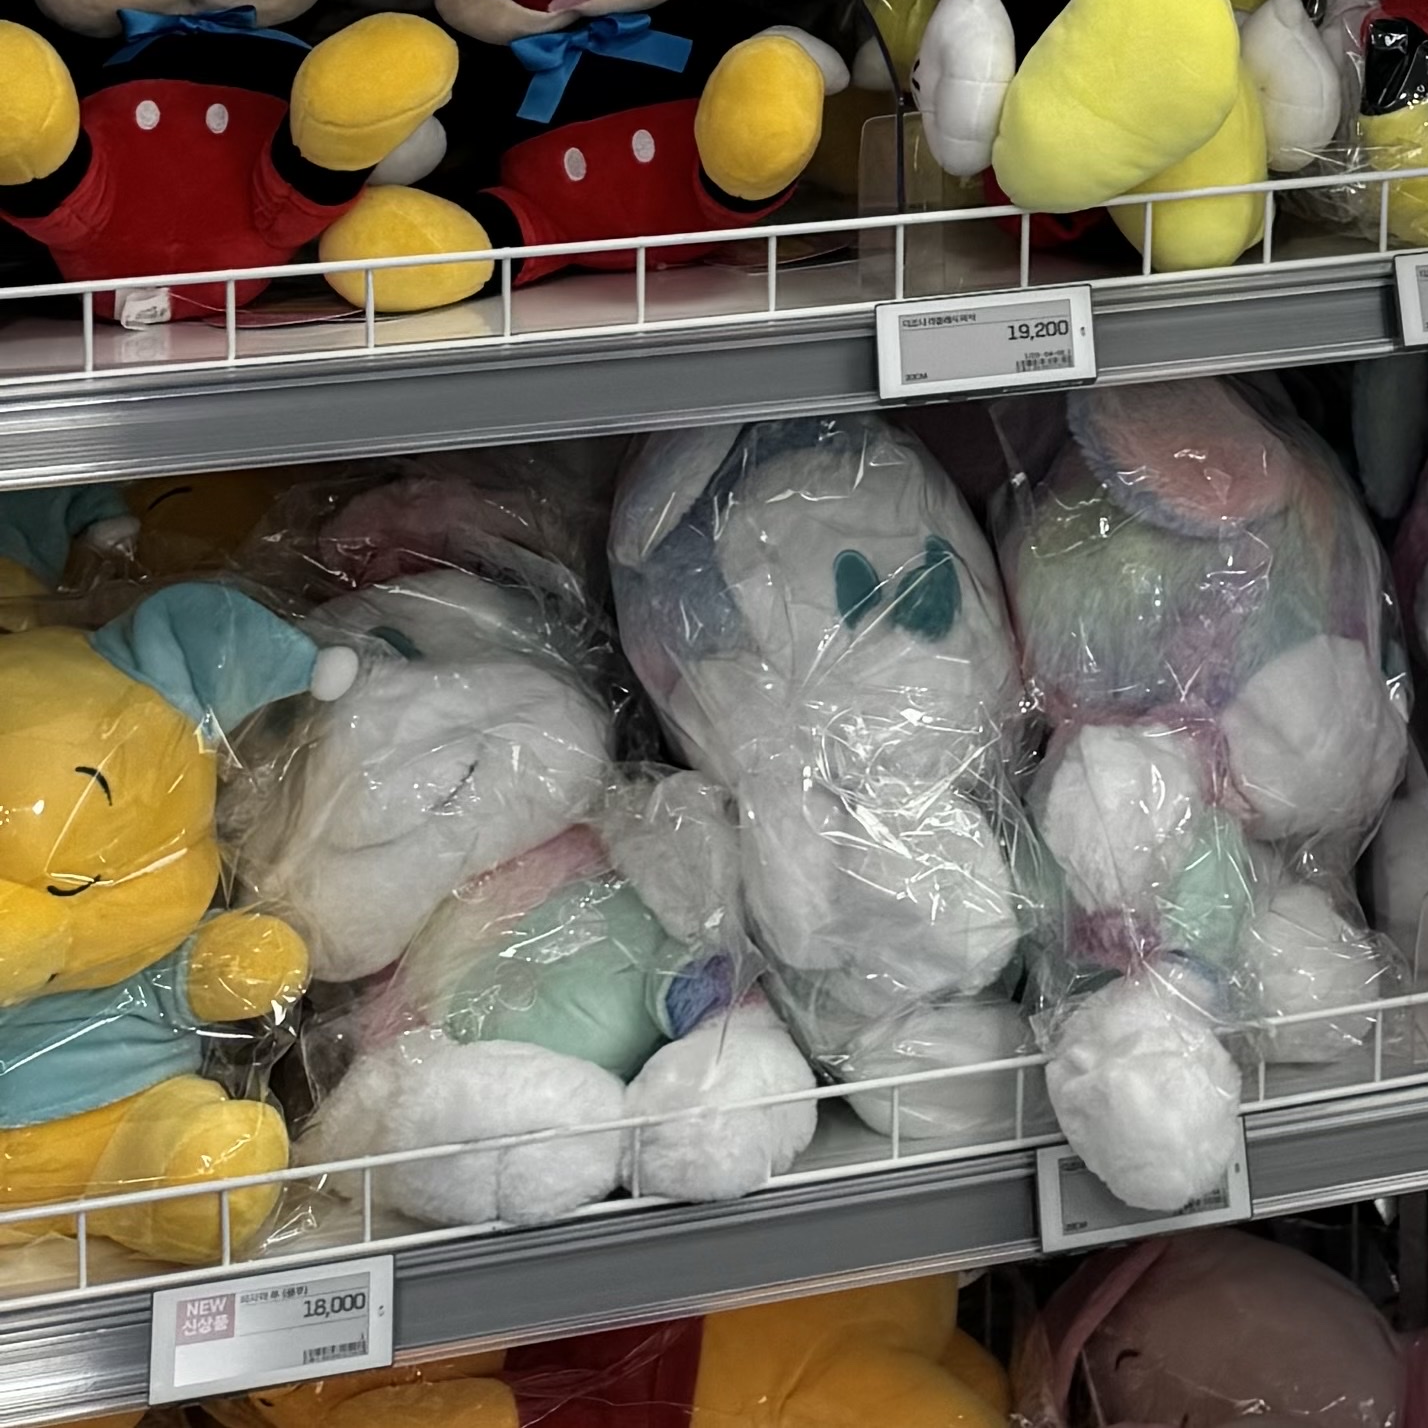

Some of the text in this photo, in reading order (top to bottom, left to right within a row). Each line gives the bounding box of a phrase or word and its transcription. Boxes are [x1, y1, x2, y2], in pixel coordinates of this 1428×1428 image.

[1007, 319, 1069, 341] 19,200
[186, 1296, 227, 1317] NEW
[303, 1292, 366, 1319] 18,000
[181, 1313, 229, 1337] 신상품
